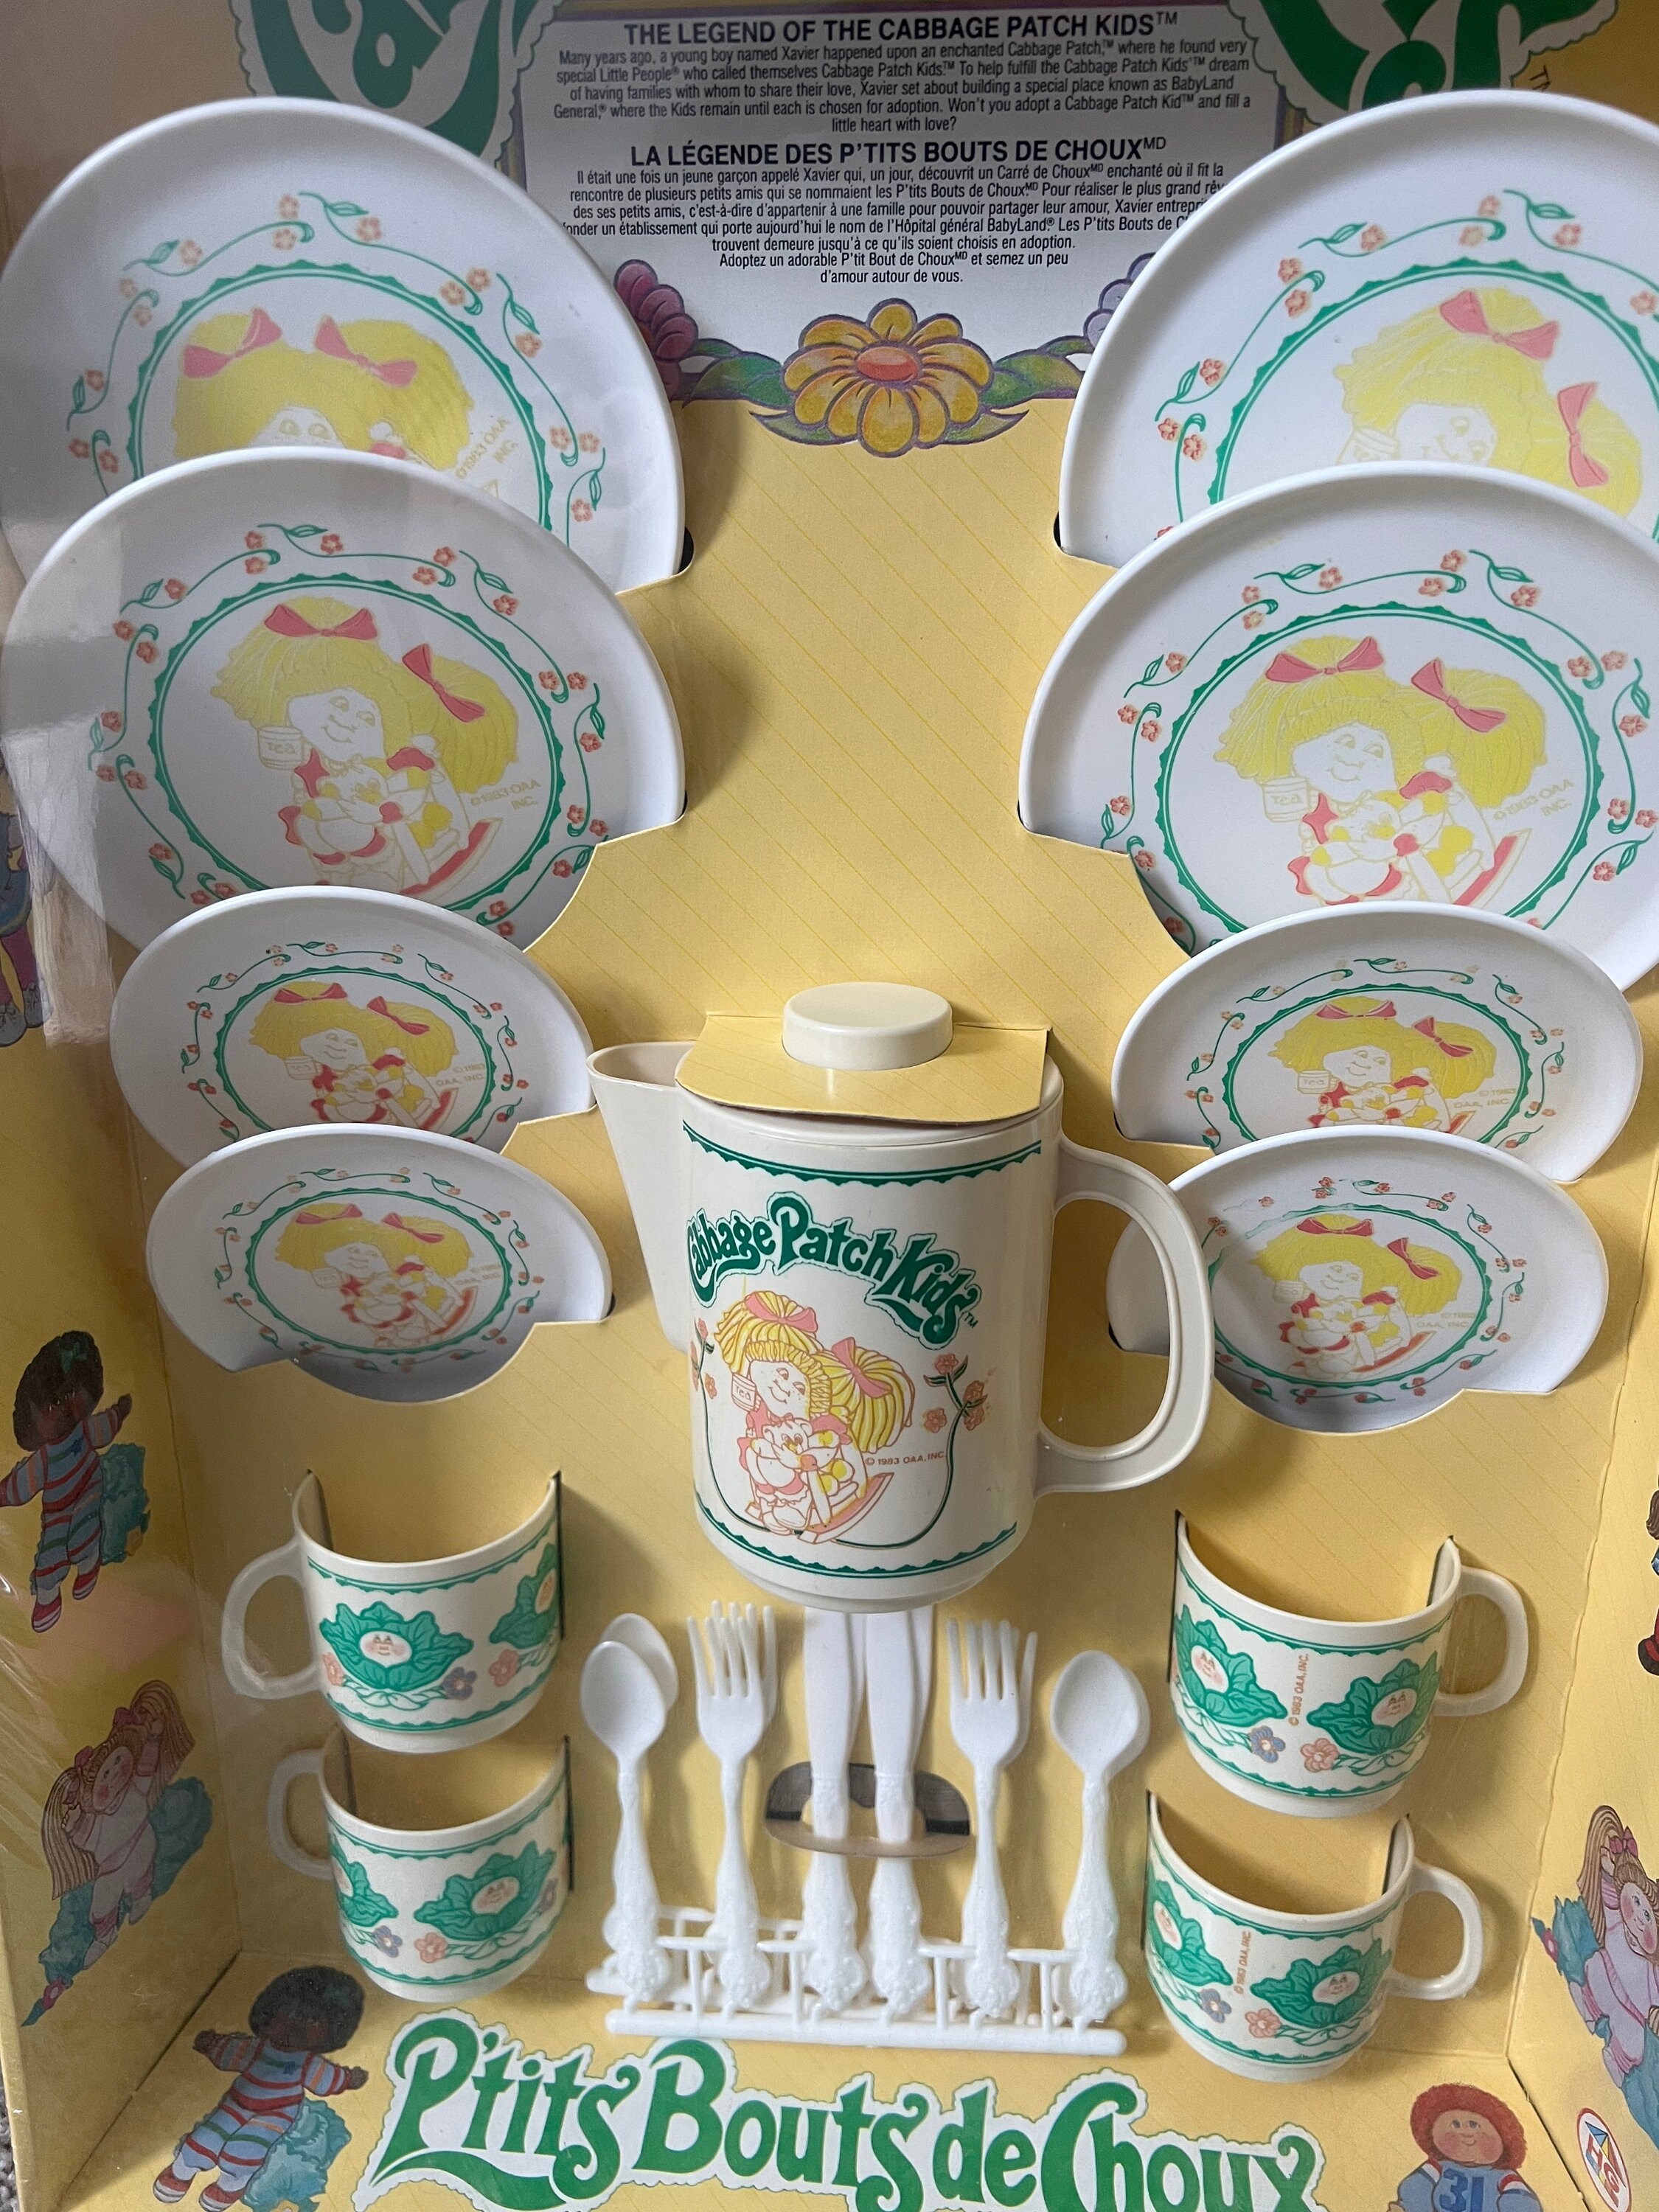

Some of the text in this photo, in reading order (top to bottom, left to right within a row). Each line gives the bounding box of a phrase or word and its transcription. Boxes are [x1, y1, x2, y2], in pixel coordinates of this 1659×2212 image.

[624, 24, 671, 46] THE
[678, 22, 776, 45] LEGEND
[783, 21, 815, 43] OF
[823, 20, 872, 42] THE
[878, 17, 999, 41] CABBAGE
[1006, 16, 1087, 38] PATCH
[559, 40, 1248, 68] Many years young named Xavier happened upon enchanted Cabbage where found very
[557, 58, 1249, 86] special Little called themselves Cabbage Patch fulfill Cabbage Patch dream
[585, 75, 1234, 103] having families whom share love, Xavier about building special place known BabyLand
[610, 95, 1158, 118] where remain each chosen adoption. Won't adopt Cabbage Patch
[860, 116, 957, 131] heart love?
[631, 145, 661, 167] LA
[668, 139, 779, 166] LÉGENDE
[785, 143, 832, 164] DES
[840, 142, 916, 164] P'TITS
[924, 141, 1007, 163] BOUTS
[1015, 140, 1048, 161] DE
[682, 164, 1163, 187] jeune garçon appelé Xavier découvrit Carré enchanté
[570, 180, 1200, 204] rencontre plusieurs petits amis nommaient P'tits Bouts Pour réaliser grand
[619, 199, 1153, 222] petits amis, c'est-à-dire d'appartenir famille pour pouvoir partager amour, Xavier
[619, 216, 1153, 237] établissement porte aujourd'hui l'Hôpital général P'tits Bouts
[712, 234, 1075, 254] trouvent demeure jusqu'à qu'ils soient choisis adoption.
[720, 252, 1024, 270] Adoptez adorable Bout semez
[820, 269, 963, 283] d'amour autour vous.
[687, 1213, 776, 1302] Cabbage
[770, 1196, 894, 1281] Patch
[877, 1458, 900, 1466] 1983
[1291, 1695, 1303, 1715] 1983
[370, 2017, 1318, 2212] P'tits Bouts de Choux
[1439, 2168, 1485, 2212] 31
